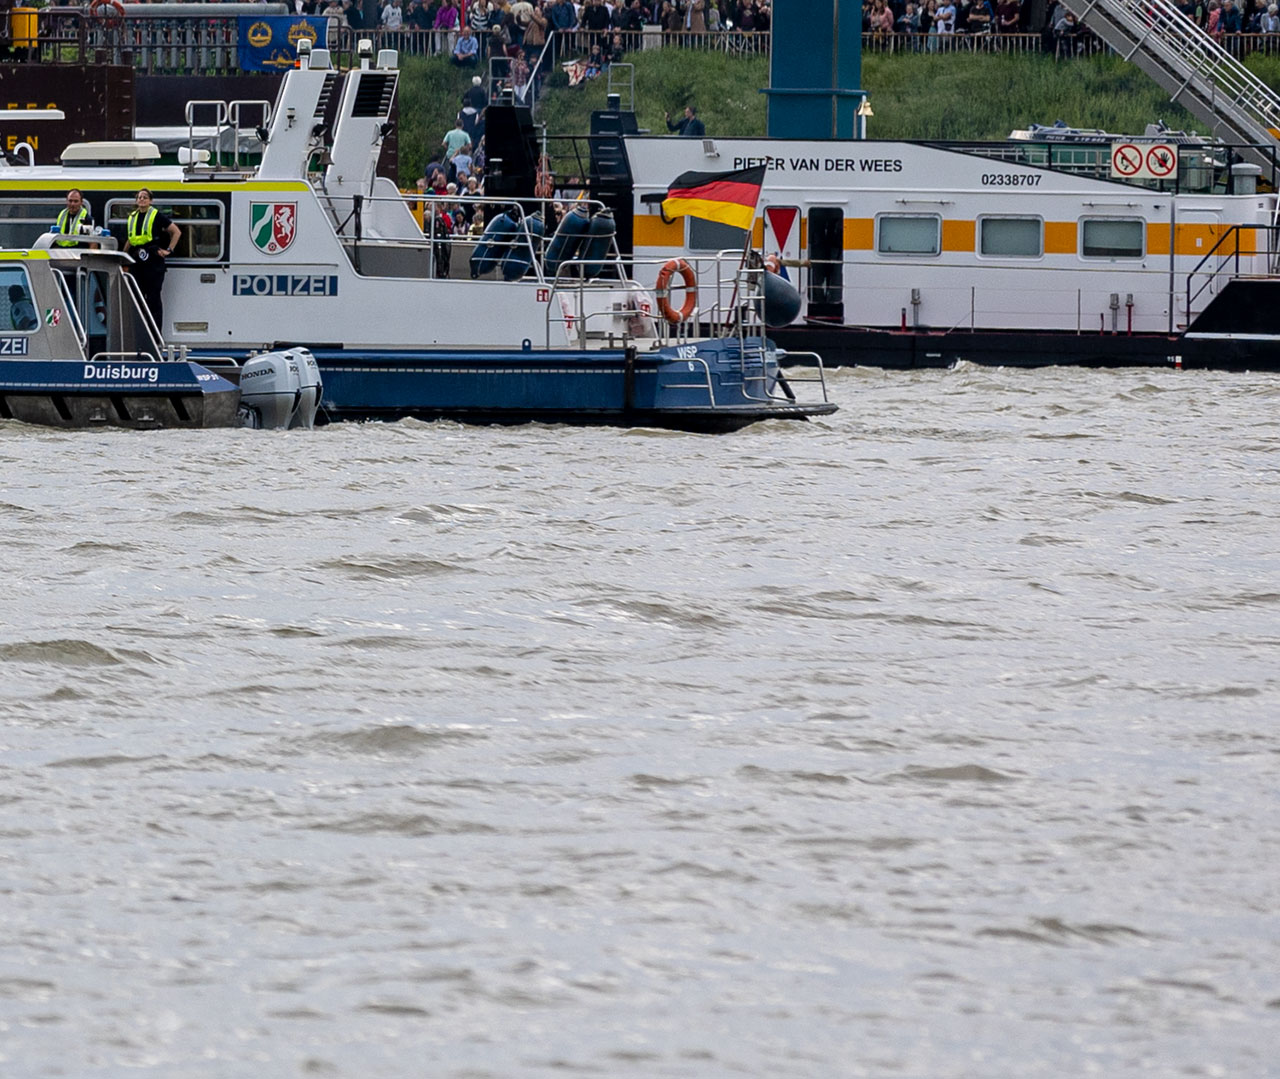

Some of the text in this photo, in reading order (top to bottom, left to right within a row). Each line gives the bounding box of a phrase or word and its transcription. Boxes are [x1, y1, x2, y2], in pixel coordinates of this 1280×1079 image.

[790, 158, 820, 171] VAN
[824, 158, 856, 172] DER
[860, 159, 903, 172] WEES
[981, 174, 1043, 187] 02338707
[235, 275, 331, 296] POLIZEI
[677, 345, 698, 360] WSP
[83, 364, 159, 383] Duisburg
[241, 367, 275, 380] HONDA
